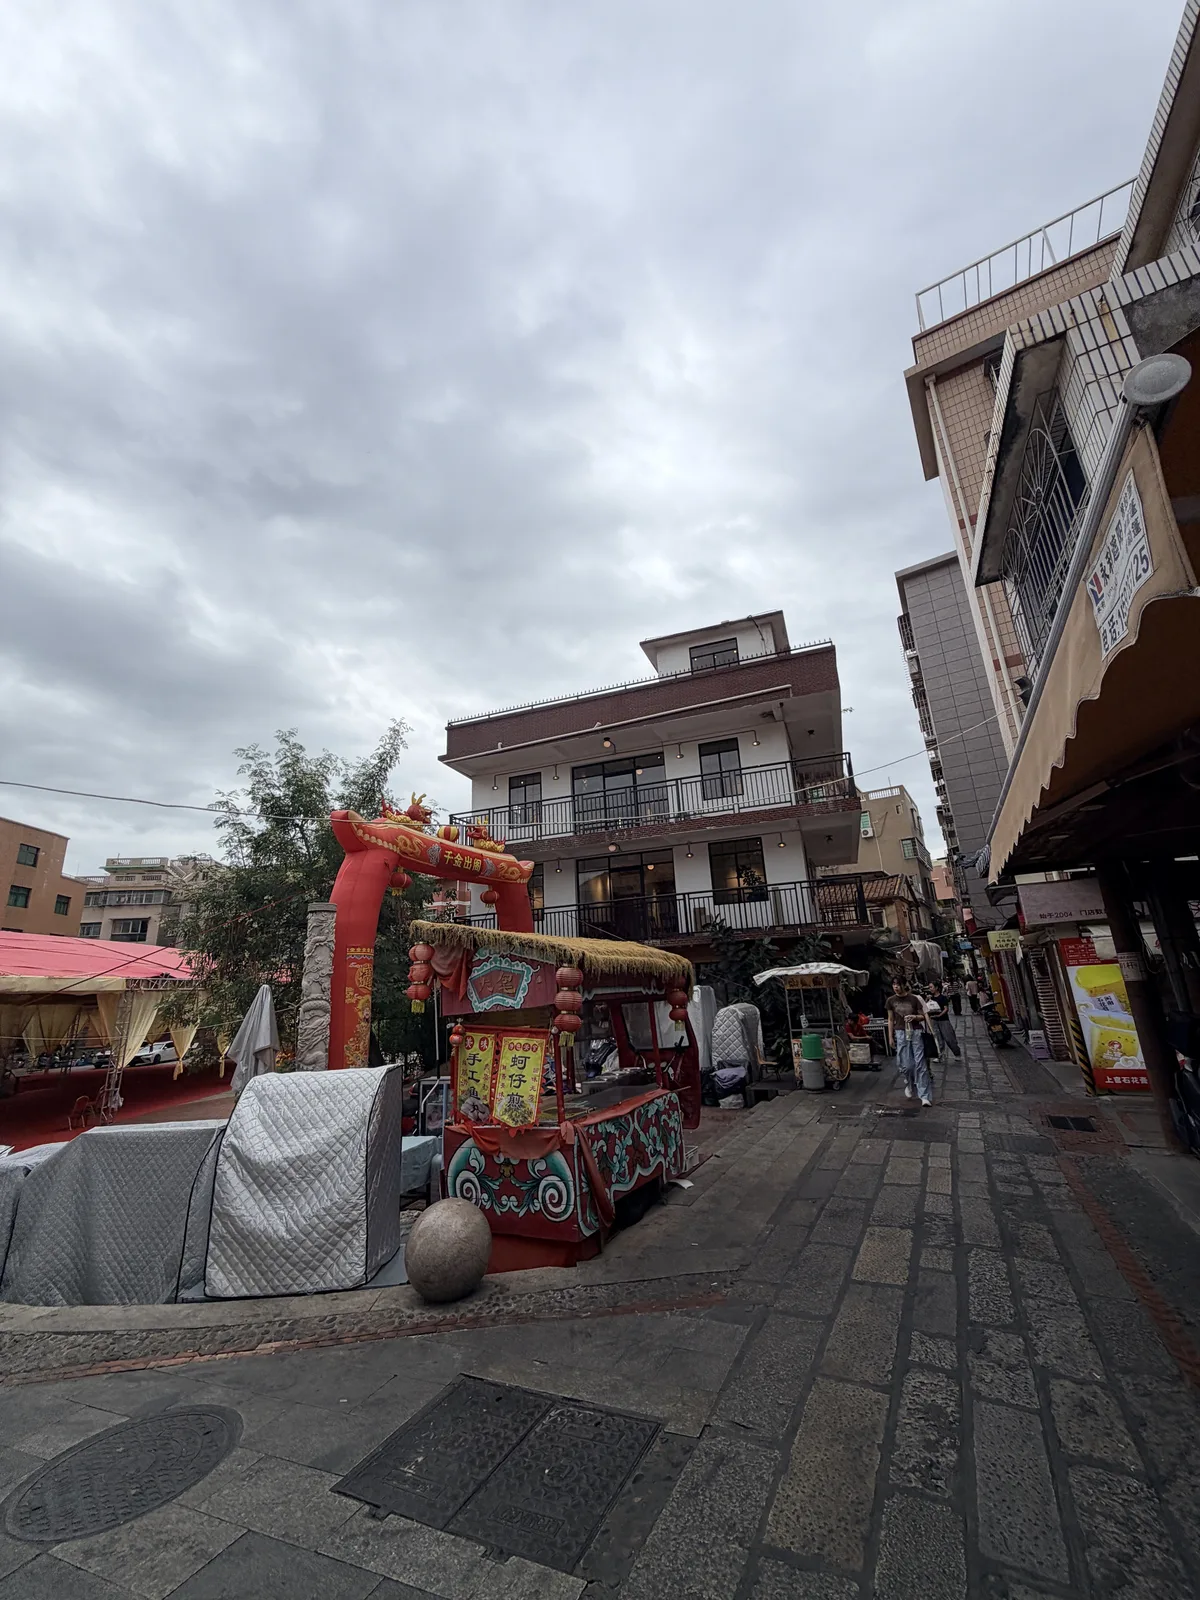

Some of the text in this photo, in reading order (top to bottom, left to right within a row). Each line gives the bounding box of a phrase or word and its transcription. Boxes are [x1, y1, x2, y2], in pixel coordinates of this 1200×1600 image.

[444, 850, 482, 872] 千金出阁
[1038, 911, 1072, 919] 始于2004
[1079, 908, 1107, 916] 门店数
[507, 1054, 531, 1108] 蚵仔煎
